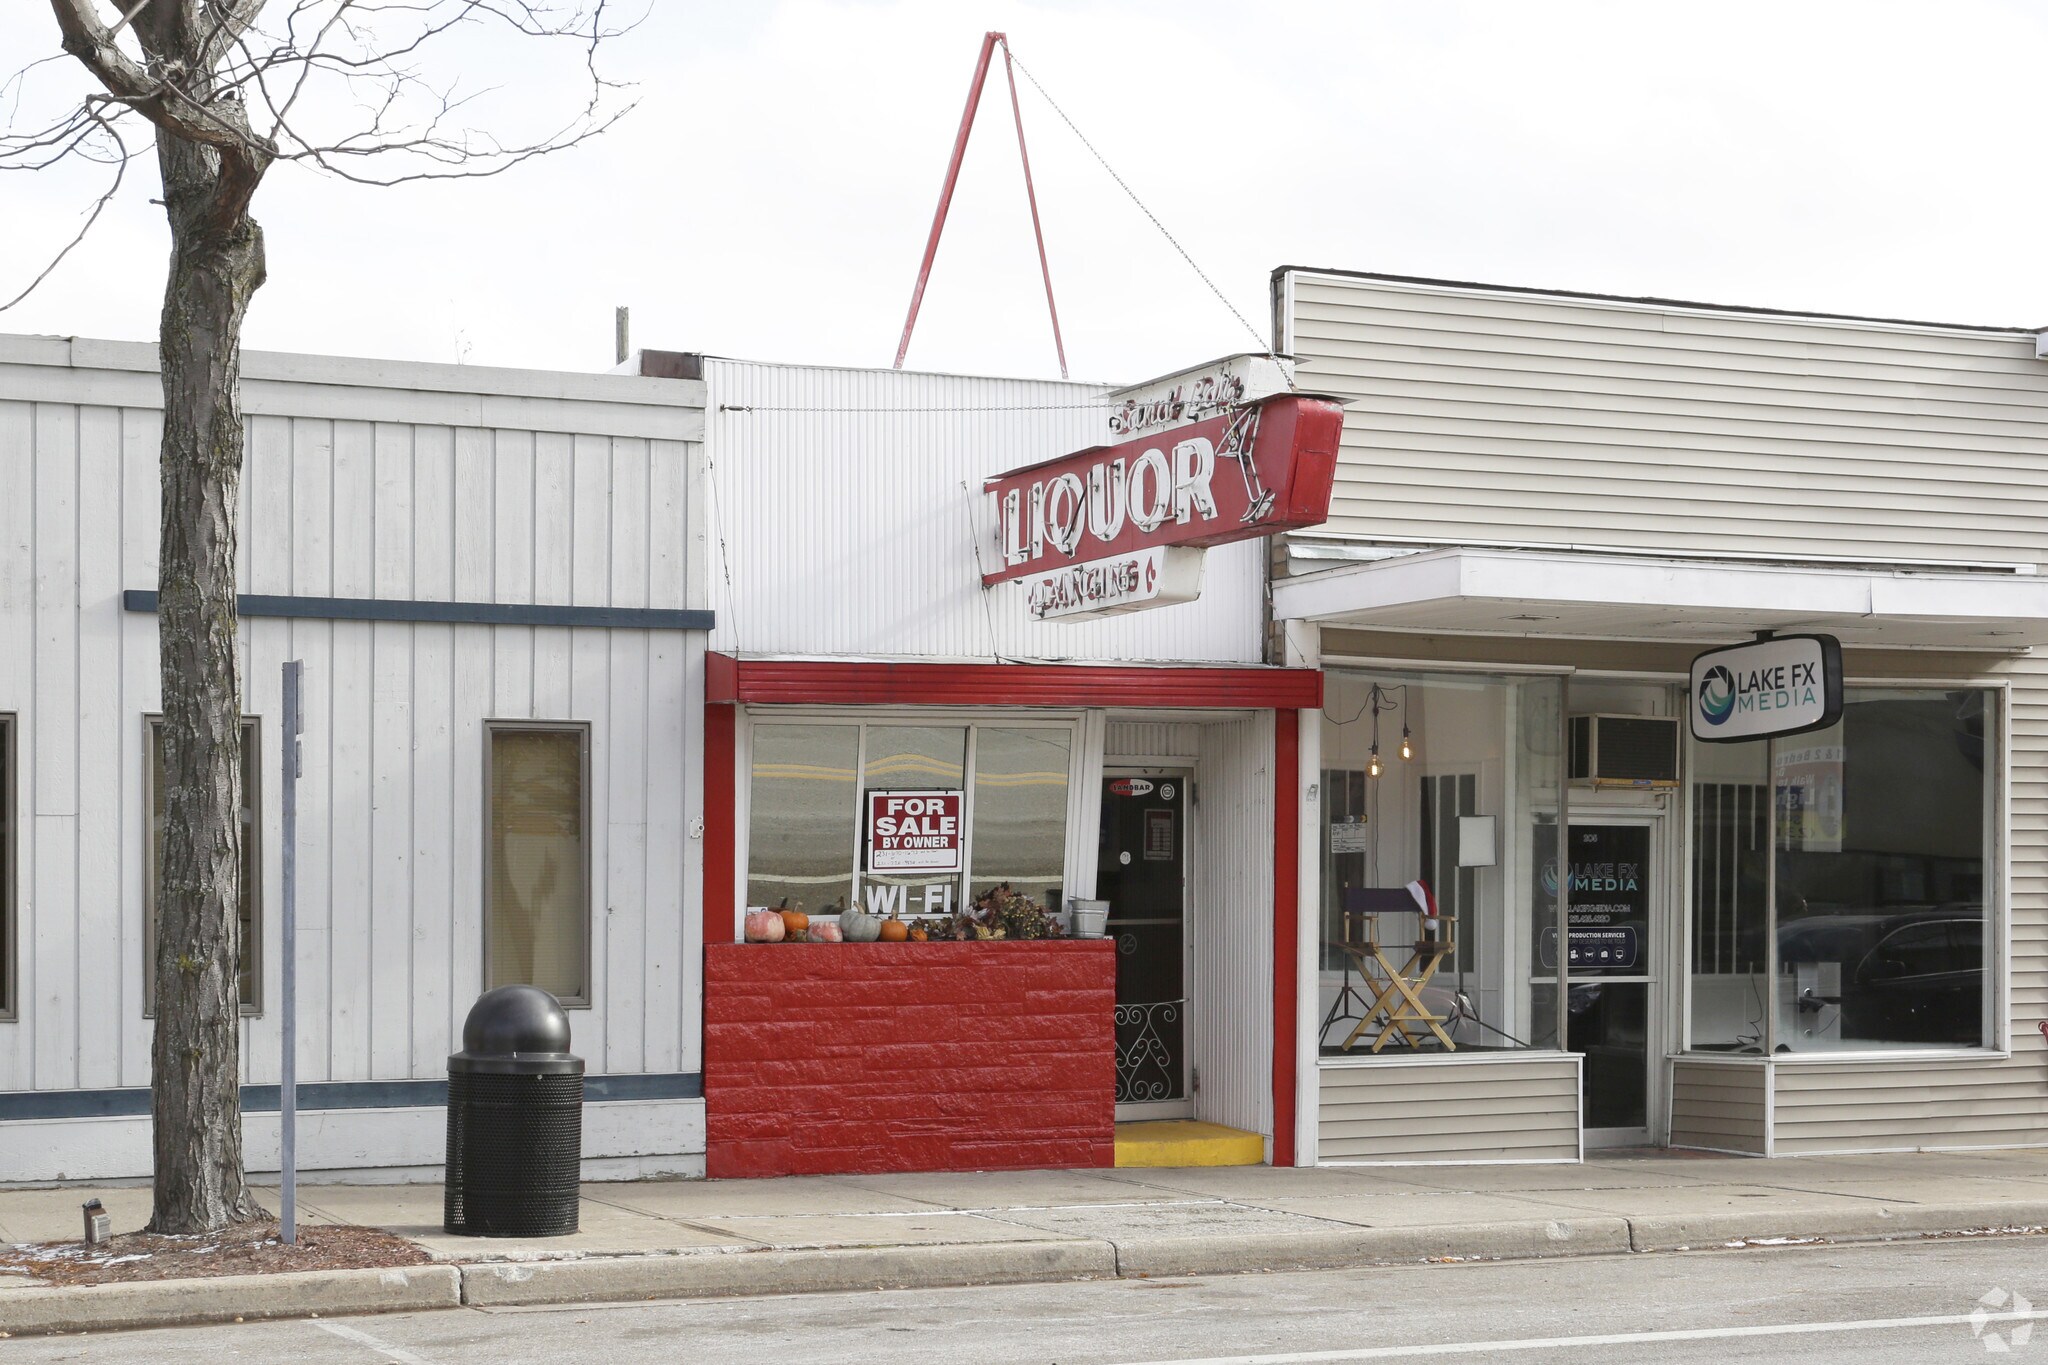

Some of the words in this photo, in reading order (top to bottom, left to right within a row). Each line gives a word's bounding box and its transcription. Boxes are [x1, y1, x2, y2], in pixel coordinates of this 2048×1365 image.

[1002, 436, 1218, 567] LIQUOR
[1028, 560, 1140, 614] DANCING
[1738, 666, 1785, 694] LAKE
[1792, 662, 1816, 688] FX
[1738, 687, 1817, 714] MEDIA
[887, 798, 945, 816] FOR
[875, 816, 957, 836] SALE
[882, 837, 899, 849] BY
[903, 836, 949, 848] OWNER
[1575, 863, 1614, 879] LAKE
[1618, 863, 1638, 879] FX
[1575, 878, 1638, 891] MEDIA
[865, 885, 952, 913] WI-FI
